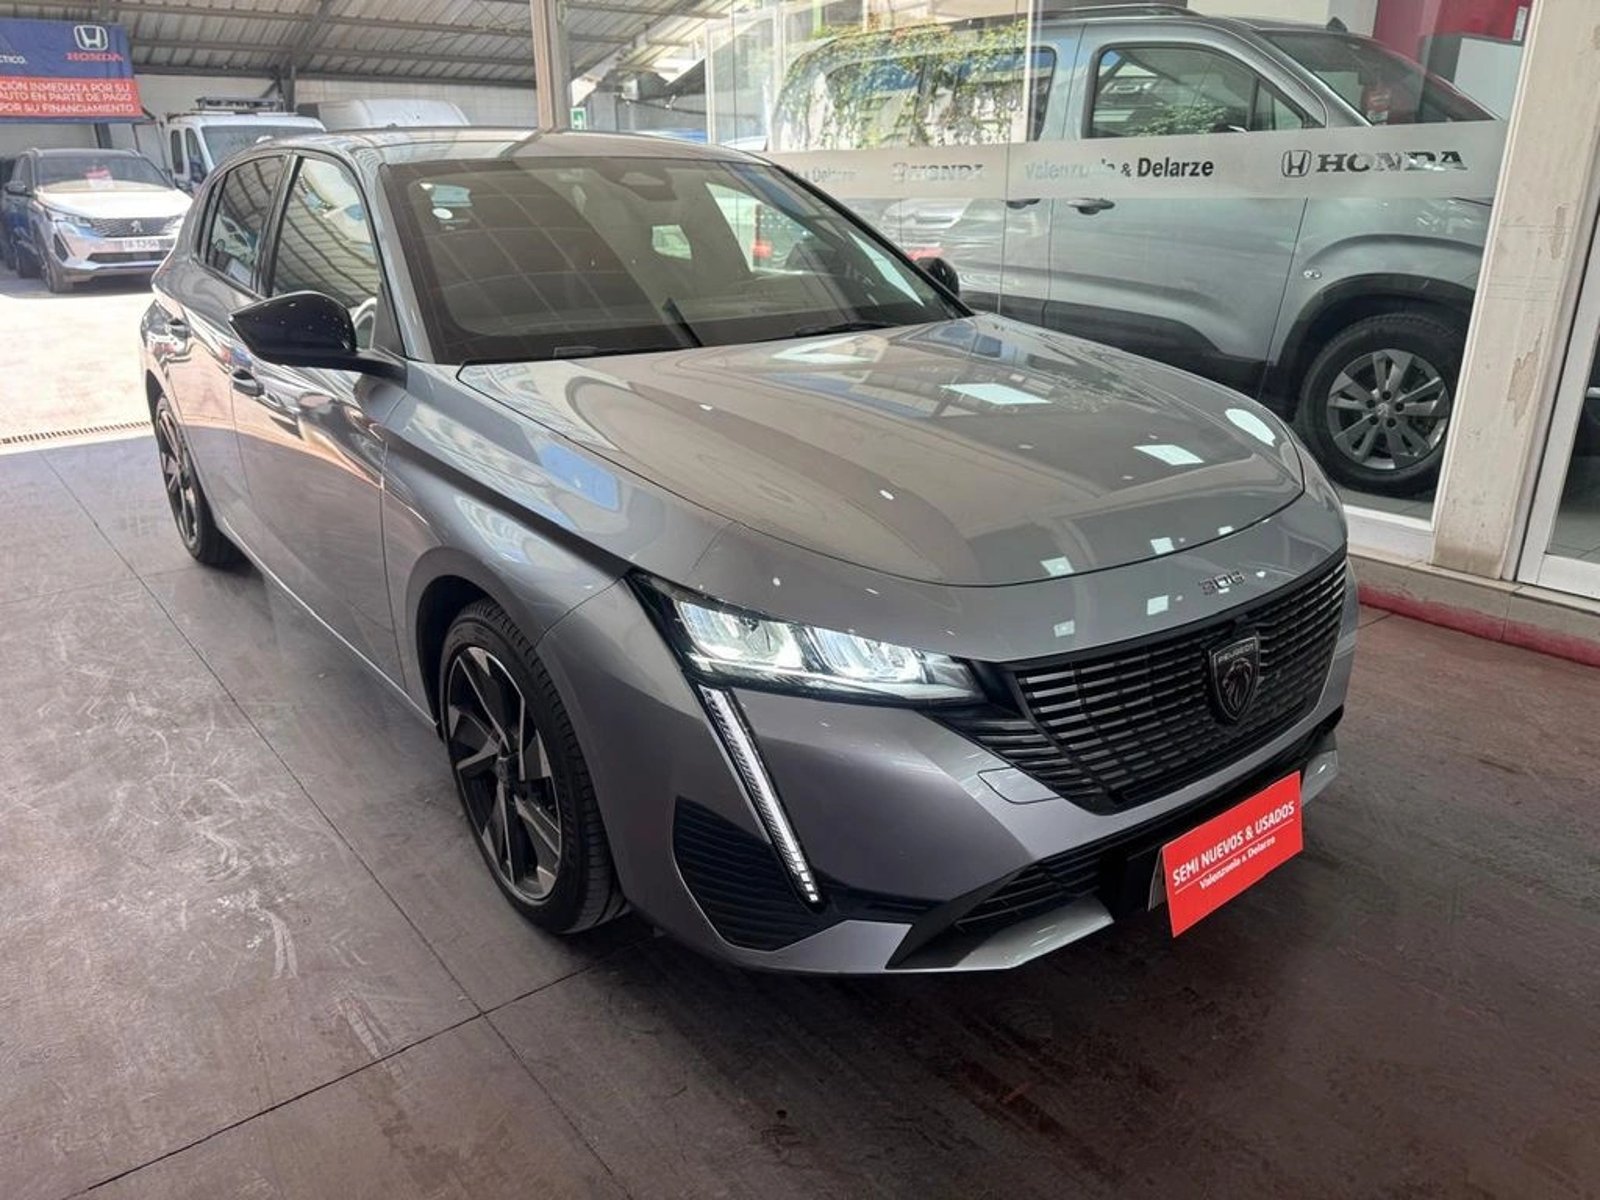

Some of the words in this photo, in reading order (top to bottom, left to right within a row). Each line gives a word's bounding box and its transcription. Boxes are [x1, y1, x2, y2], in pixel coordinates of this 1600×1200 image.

[65, 52, 124, 62] HONDA
[30, 81, 89, 92] INMEDIATA
[90, 82, 112, 92] POR
[114, 82, 130, 93] SU
[30, 91, 49, 101] EN
[49, 92, 83, 102] PARTE
[84, 93, 102, 102] DE
[102, 93, 132, 102] PAGO
[24, 102, 40, 112] SU
[42, 103, 134, 113] FINANCIAMIENTO
[1120, 162, 1132, 178] &
[1137, 156, 1214, 178] Delarze
[1316, 151, 1469, 173] HONDA
[1172, 857, 1199, 887] SEMI
[1201, 830, 1243, 868] NUEVOS
[1245, 825, 1254, 841] &
[1254, 800, 1295, 835] USADOS
[1199, 857, 1242, 890] Valenzuela
[1247, 836, 1276, 858] Delarze
